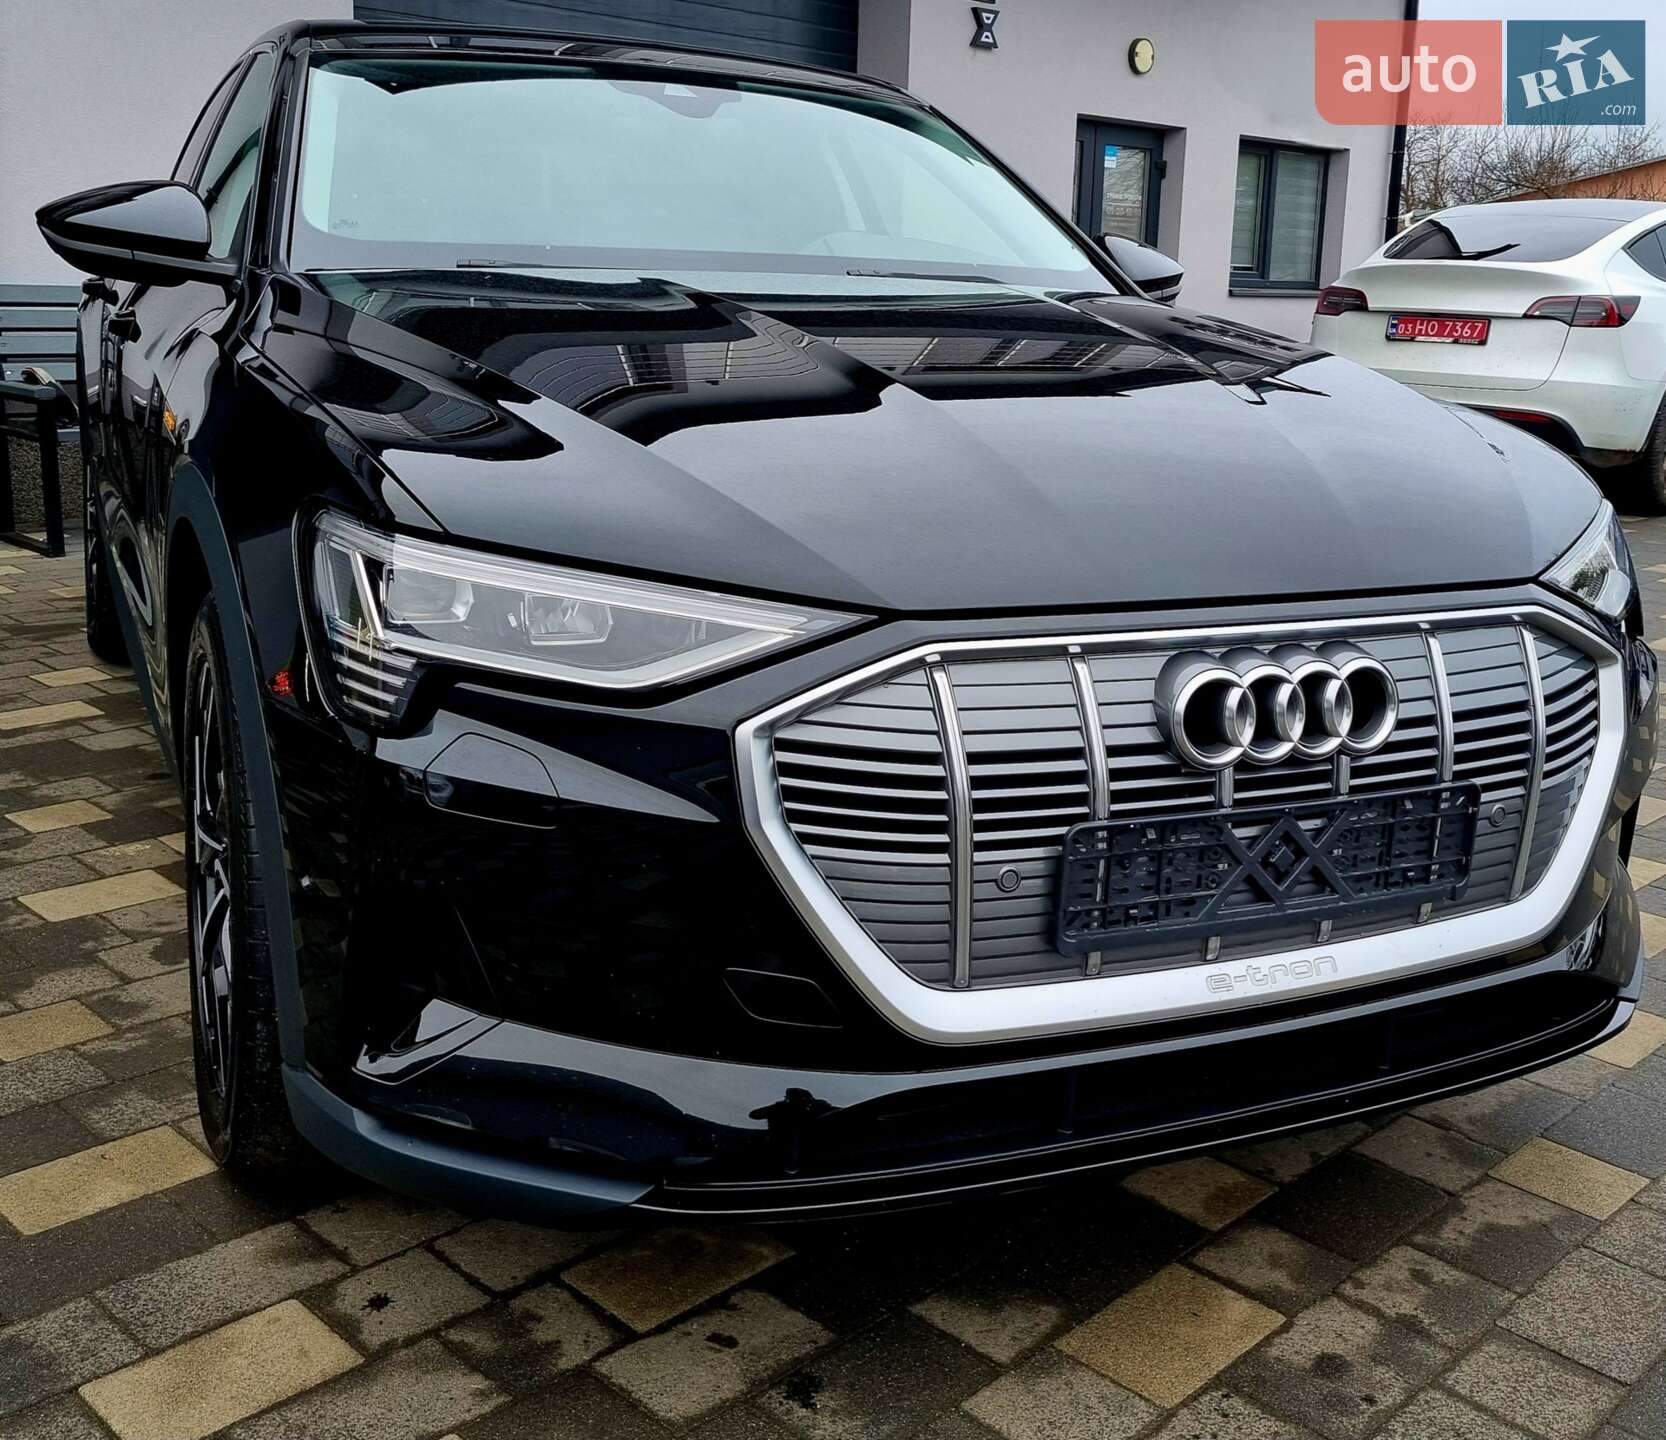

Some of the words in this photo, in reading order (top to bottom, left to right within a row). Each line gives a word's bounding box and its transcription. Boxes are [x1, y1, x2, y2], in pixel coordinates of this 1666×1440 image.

[1398, 323, 1413, 334] 03
[1415, 320, 1438, 335] HO
[1443, 321, 1483, 338] 7367
[1205, 955, 1338, 994] e-tron
